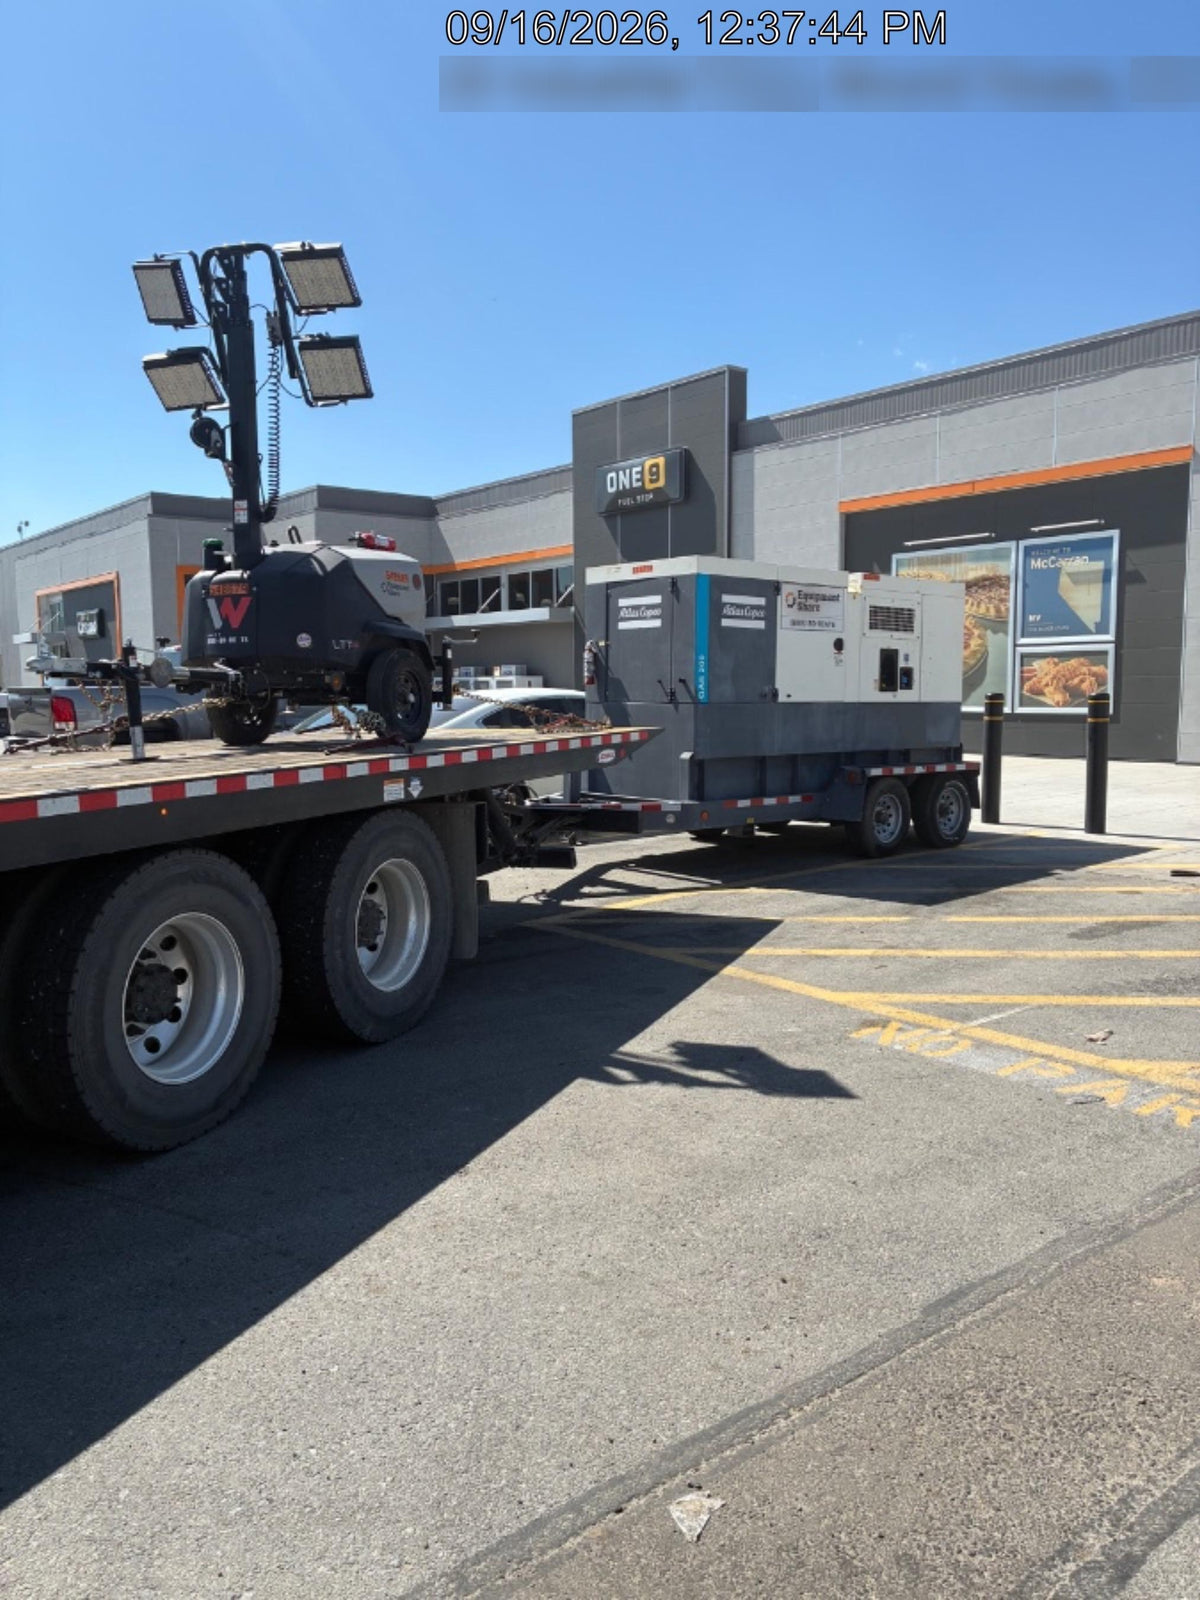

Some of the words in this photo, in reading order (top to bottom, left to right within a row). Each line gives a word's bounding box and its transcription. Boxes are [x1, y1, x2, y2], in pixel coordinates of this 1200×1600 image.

[618, 606, 638, 618] Atlas
[639, 606, 662, 619] Copco
[721, 604, 743, 615] Atlas
